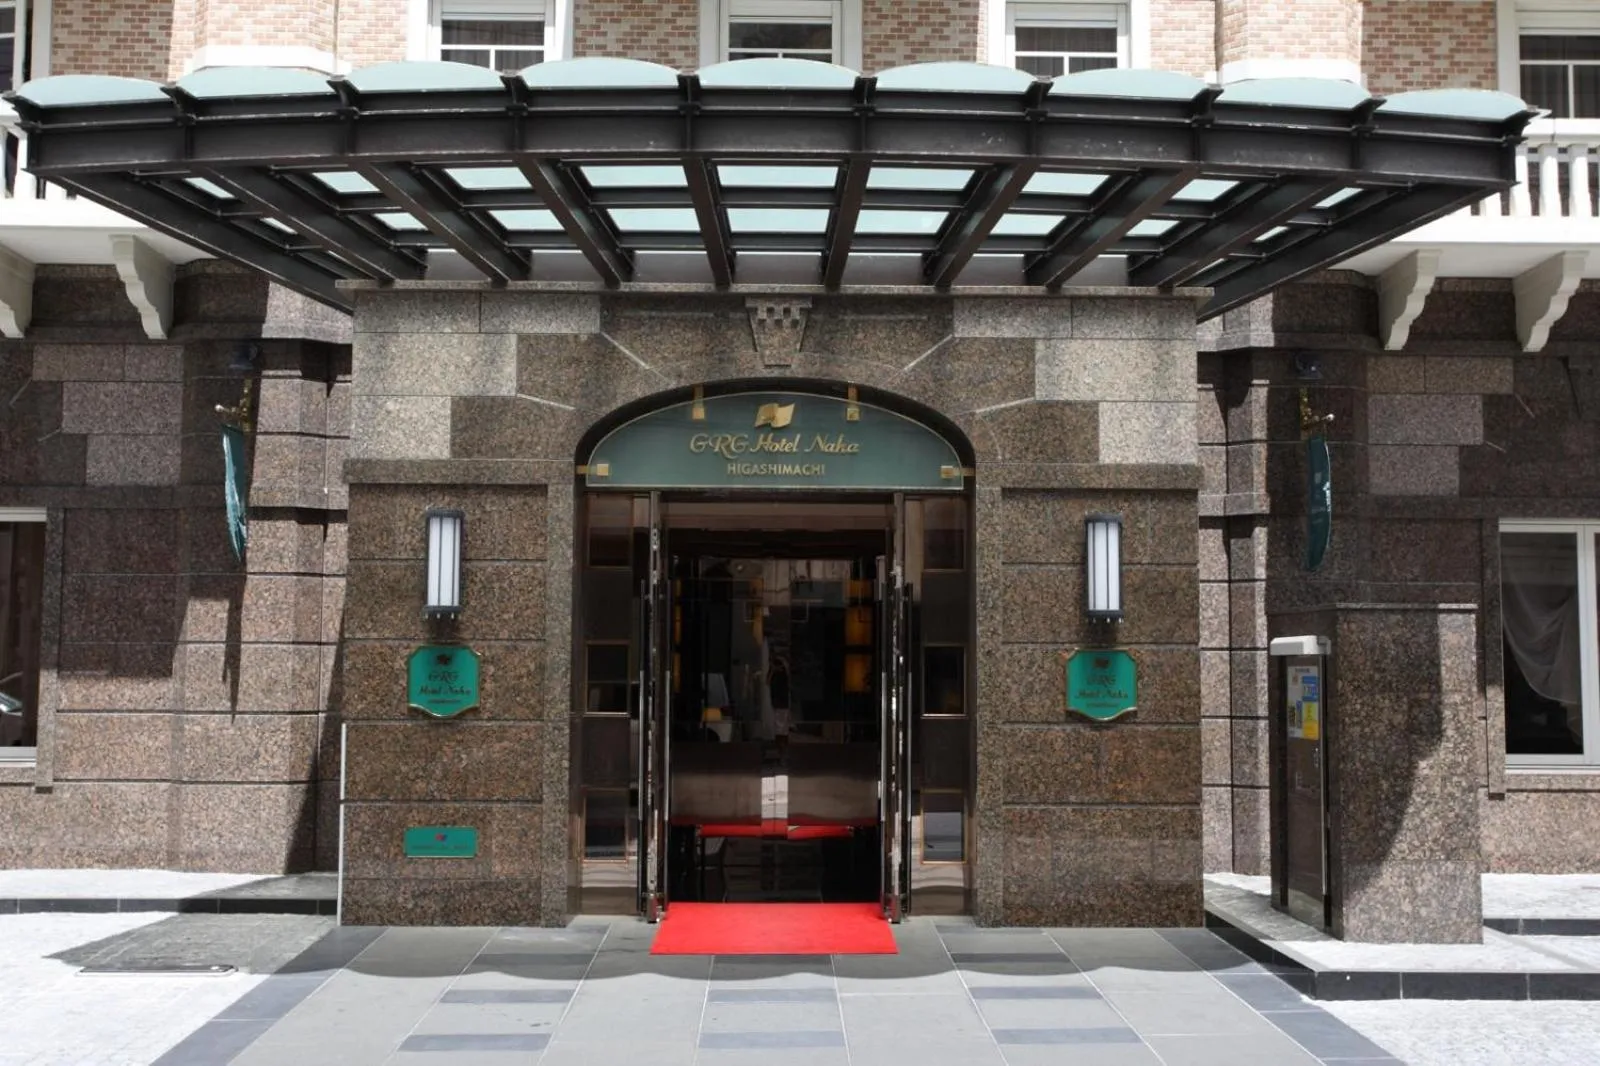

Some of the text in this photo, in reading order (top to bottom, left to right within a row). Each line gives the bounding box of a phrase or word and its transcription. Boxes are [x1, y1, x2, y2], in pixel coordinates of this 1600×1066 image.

[689, 432, 860, 459] GRG Hotel Naha
[727, 463, 826, 476] HIGASHIMACHI
